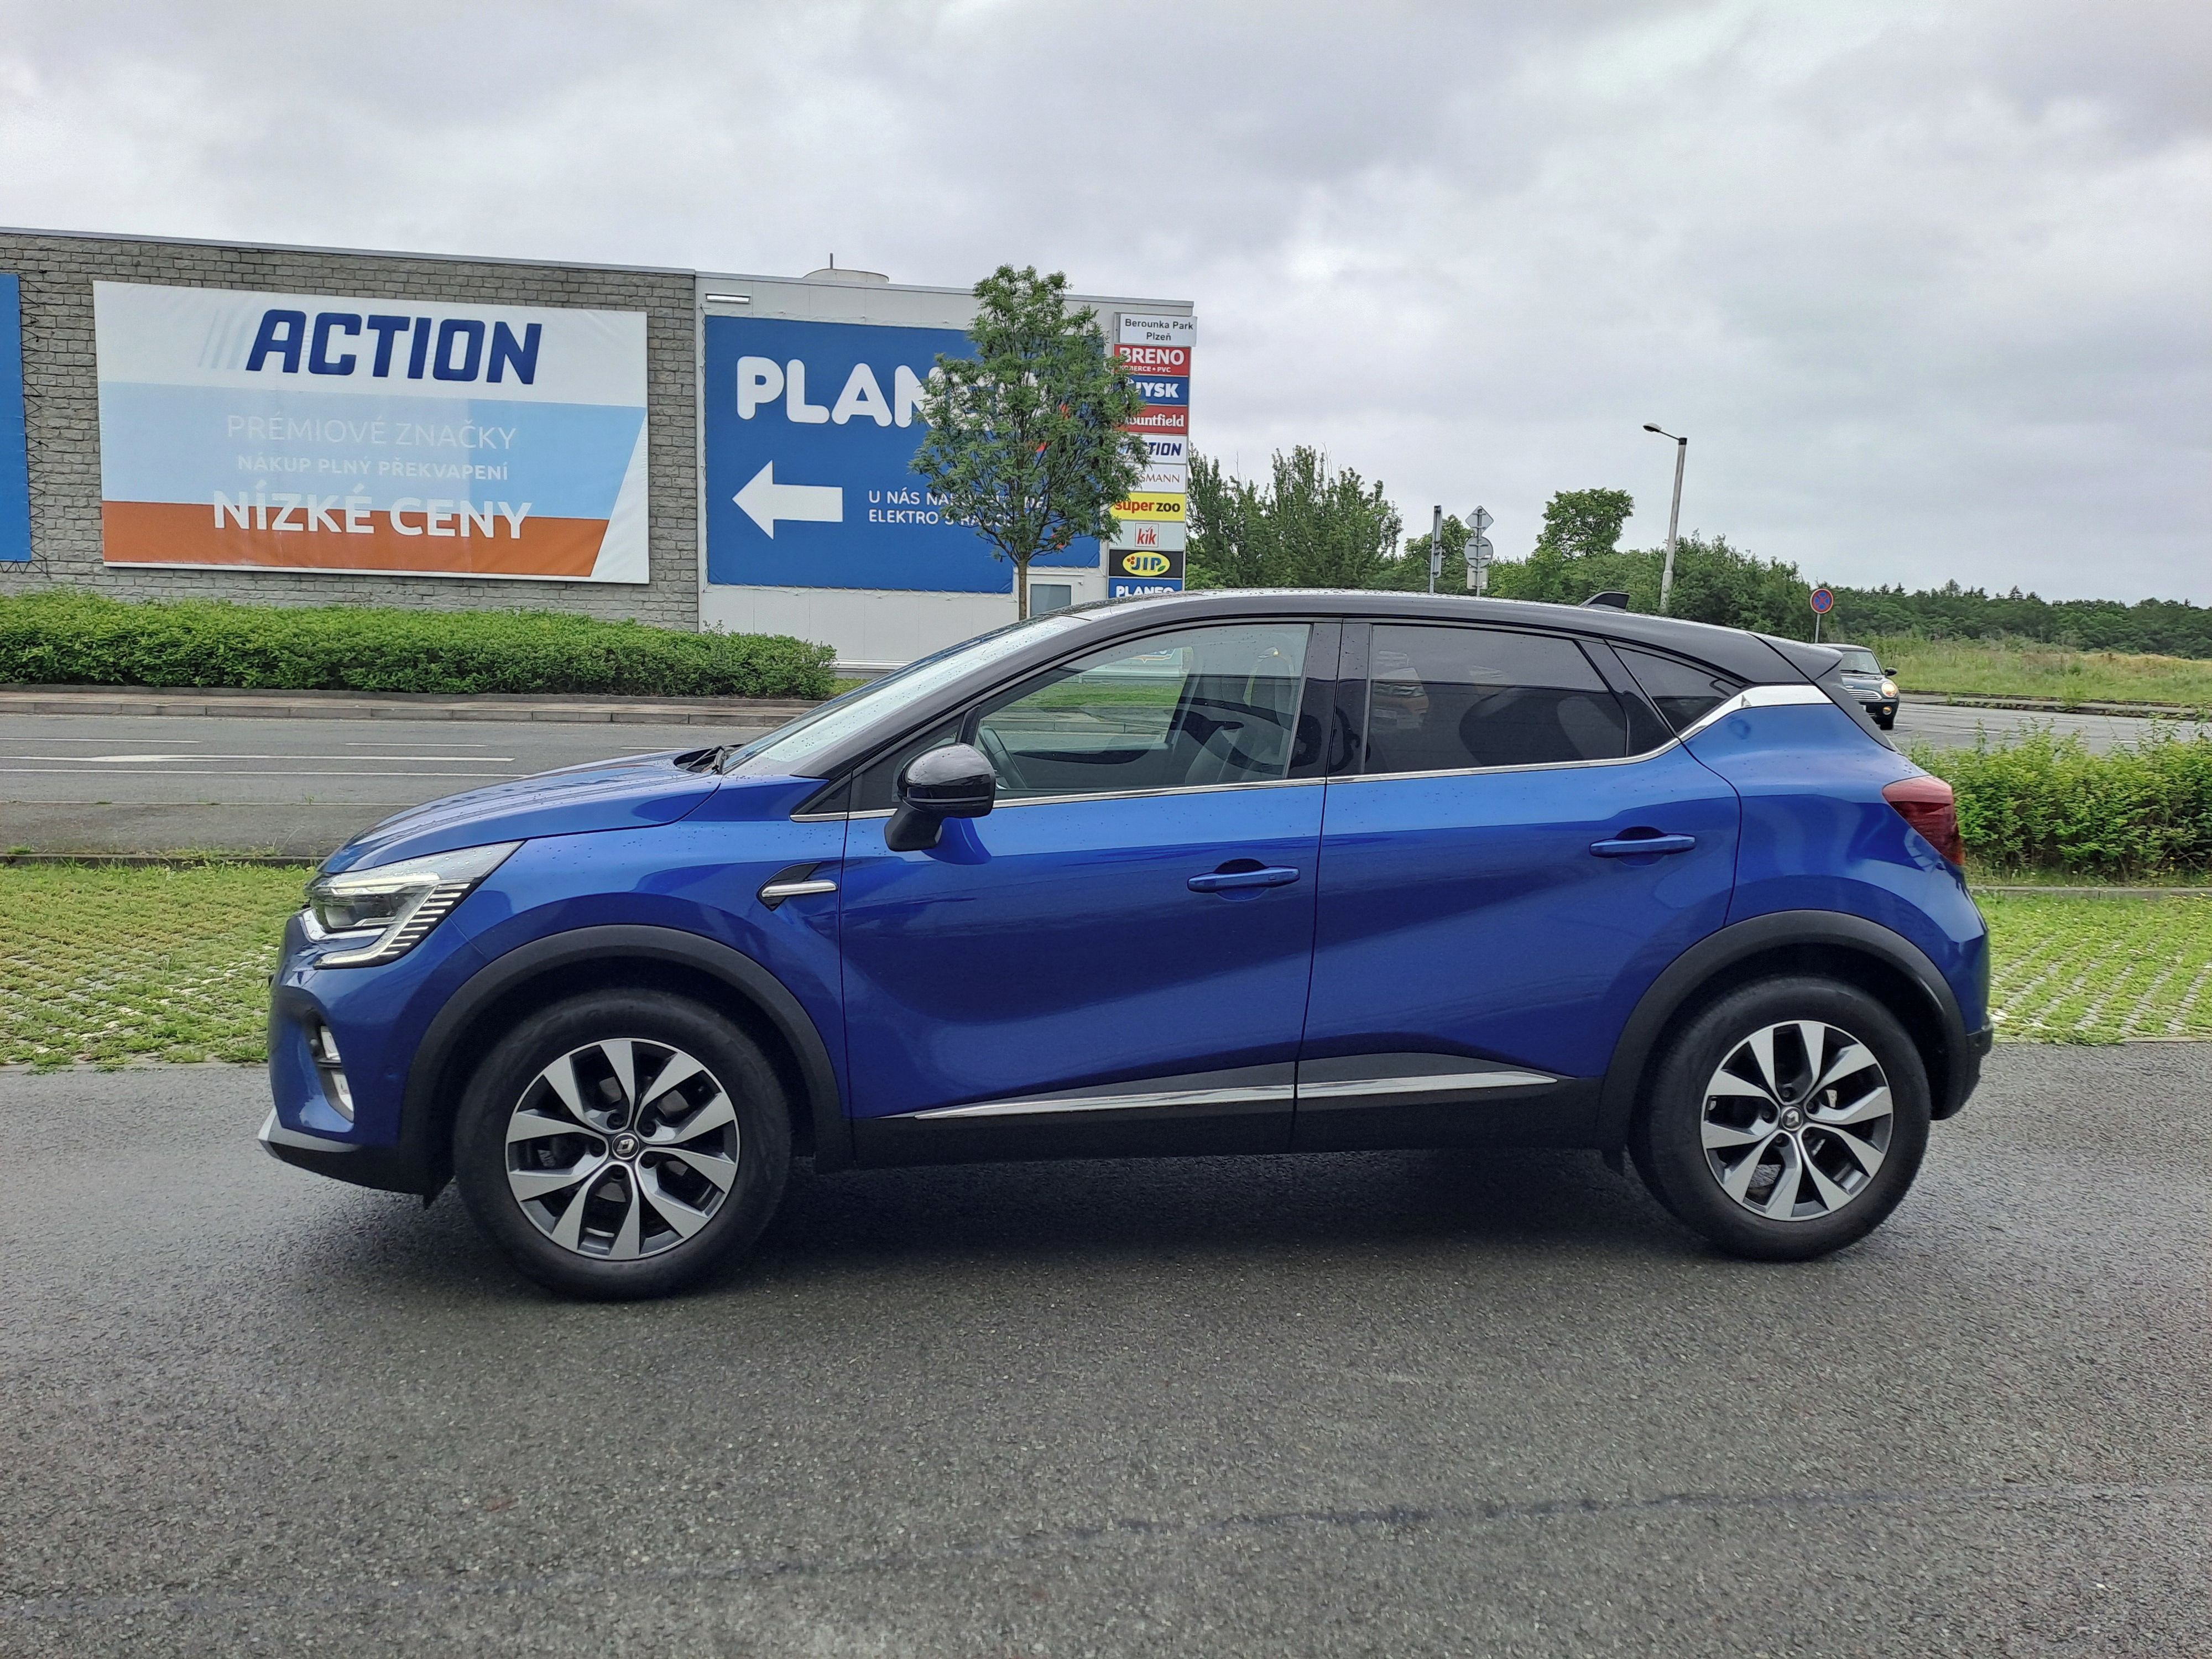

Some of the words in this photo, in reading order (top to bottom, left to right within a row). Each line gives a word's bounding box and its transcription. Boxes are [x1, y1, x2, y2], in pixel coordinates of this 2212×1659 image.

[1125, 319, 1169, 329] Berounka
[1172, 321, 1193, 330] Park
[1146, 332, 1171, 341] Plzeň
[245, 309, 542, 385] ACTION
[1120, 347, 1185, 366] BRENO
[1135, 382, 1180, 398] JYSK
[227, 411, 386, 444] PRÉMIOVÉ
[395, 419, 517, 450] ZNAČKY
[1126, 442, 1182, 456] ATION
[238, 452, 311, 472] NÁKUP
[318, 456, 372, 475] PLNÝ
[378, 456, 508, 481] PŘEKVAPENÍ
[1136, 473, 1180, 483] SMANN
[868, 490, 880, 504] U
[886, 487, 920, 505] NÁS
[213, 479, 375, 534] NÍZKÉ
[390, 497, 532, 539] CENY
[868, 509, 938, 525] ELEKTRO
[1136, 526, 1157, 545] kik
[1131, 556, 1162, 571] JIP
